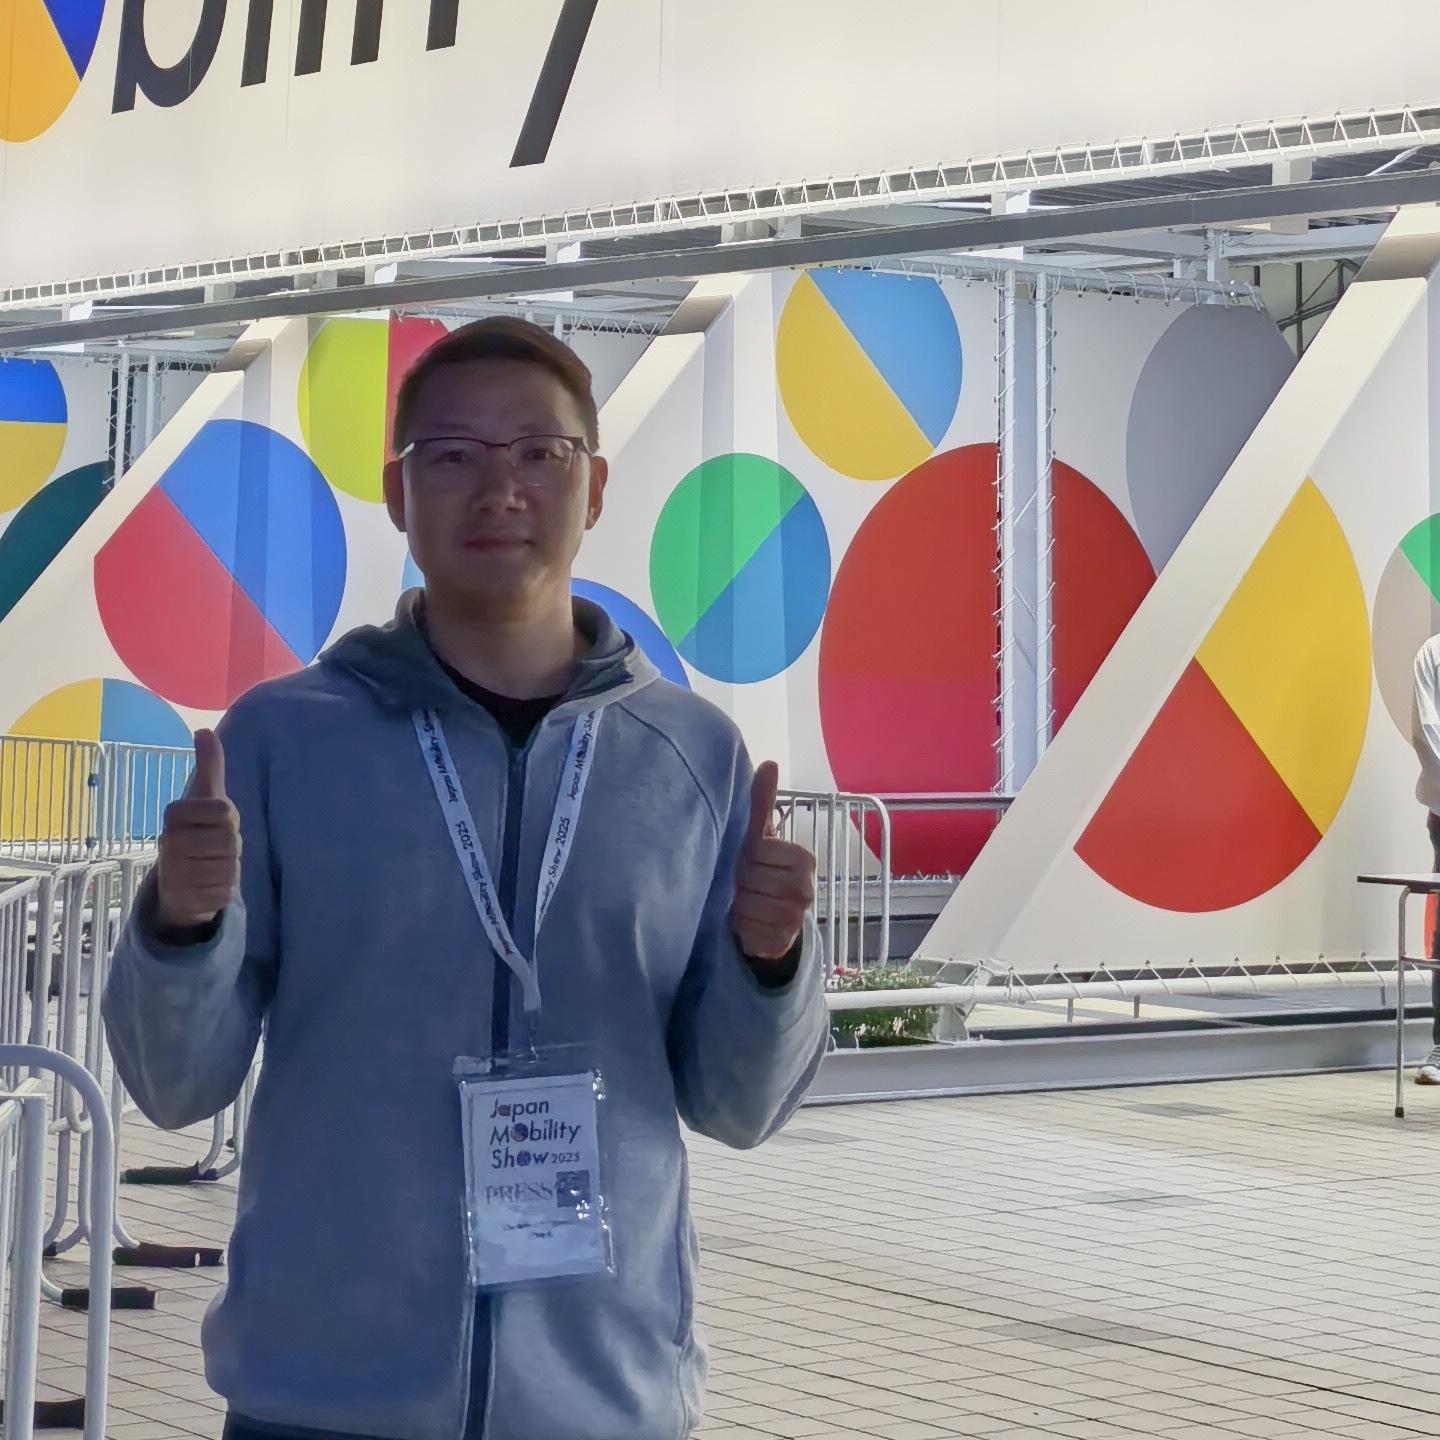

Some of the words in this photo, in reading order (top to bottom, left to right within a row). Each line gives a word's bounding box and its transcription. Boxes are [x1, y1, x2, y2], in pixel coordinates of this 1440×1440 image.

[455, 820, 474, 851] 2025
[489, 1099, 549, 1122] Japan
[489, 1119, 581, 1145] Mobility
[491, 1146, 549, 1169] Show
[551, 1151, 581, 1164] 2025
